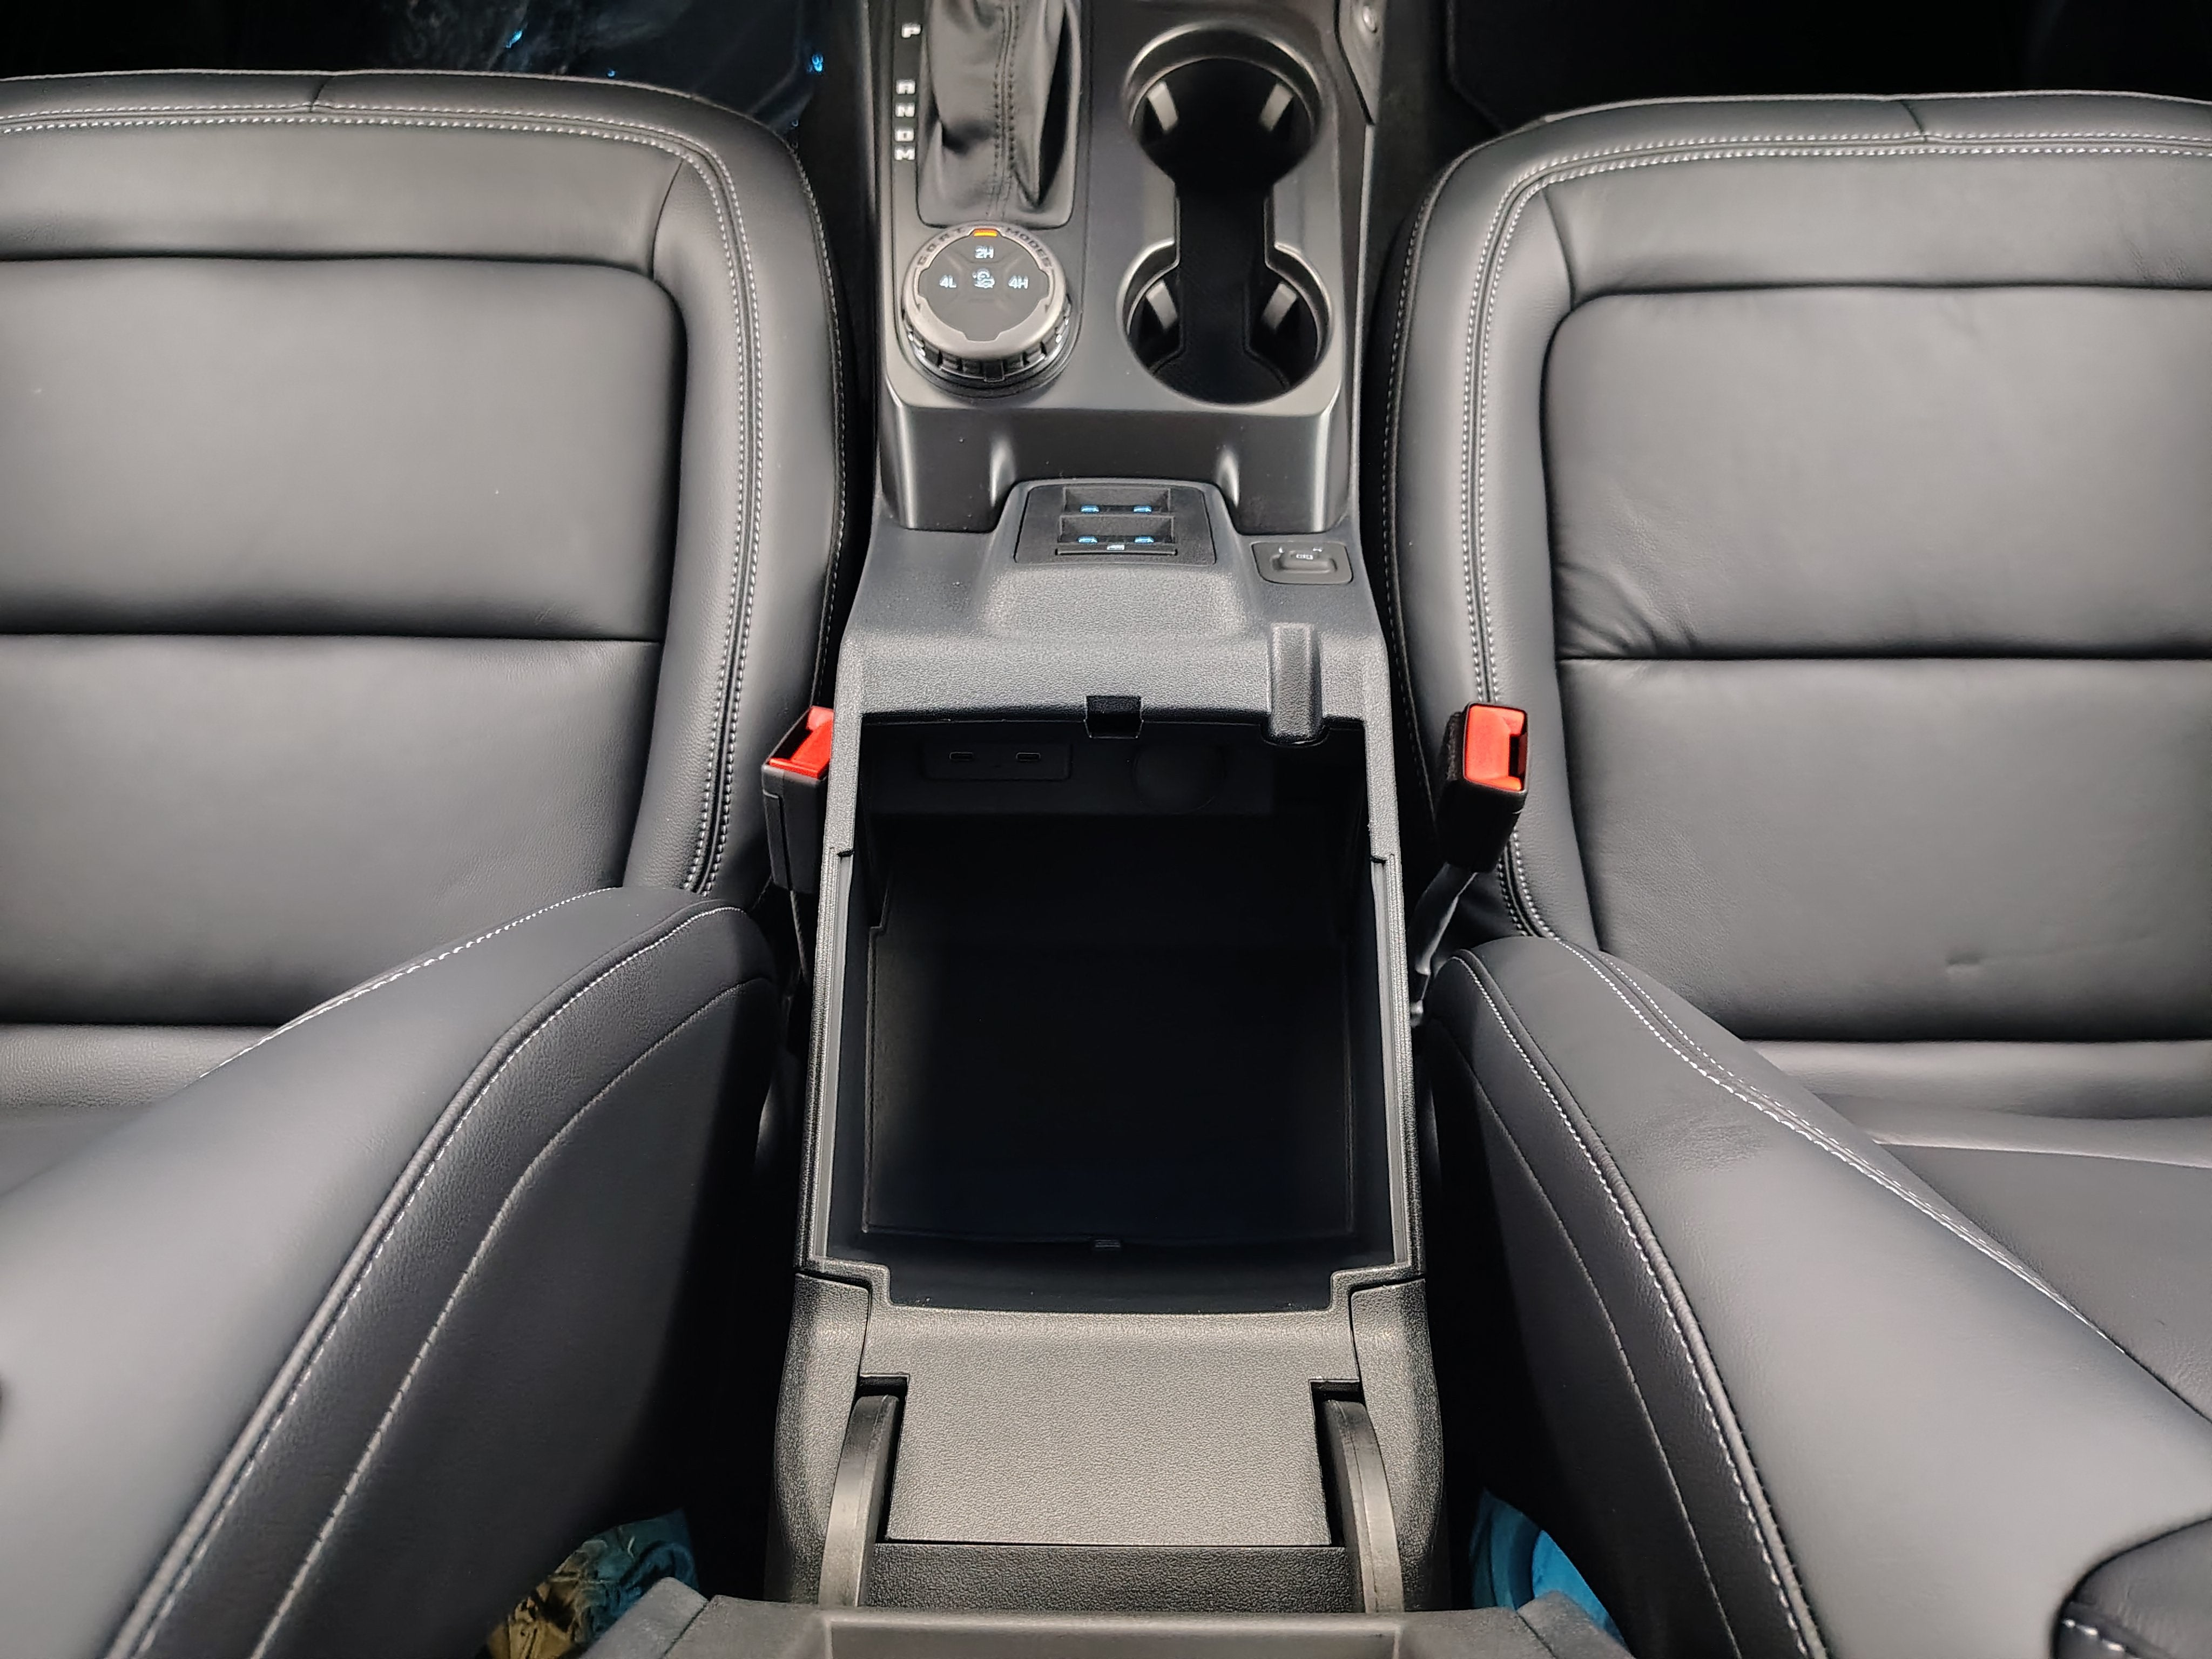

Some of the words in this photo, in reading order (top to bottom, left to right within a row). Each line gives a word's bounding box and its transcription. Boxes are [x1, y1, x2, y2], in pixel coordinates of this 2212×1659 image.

[901, 23, 921, 38] P
[895, 103, 915, 117] N
[894, 127, 914, 142] D
[894, 146, 915, 160] M
[975, 245, 994, 259] 2H
[1006, 227, 1053, 267] MODES
[939, 275, 957, 288] 4L
[1008, 275, 1028, 289] 4H
